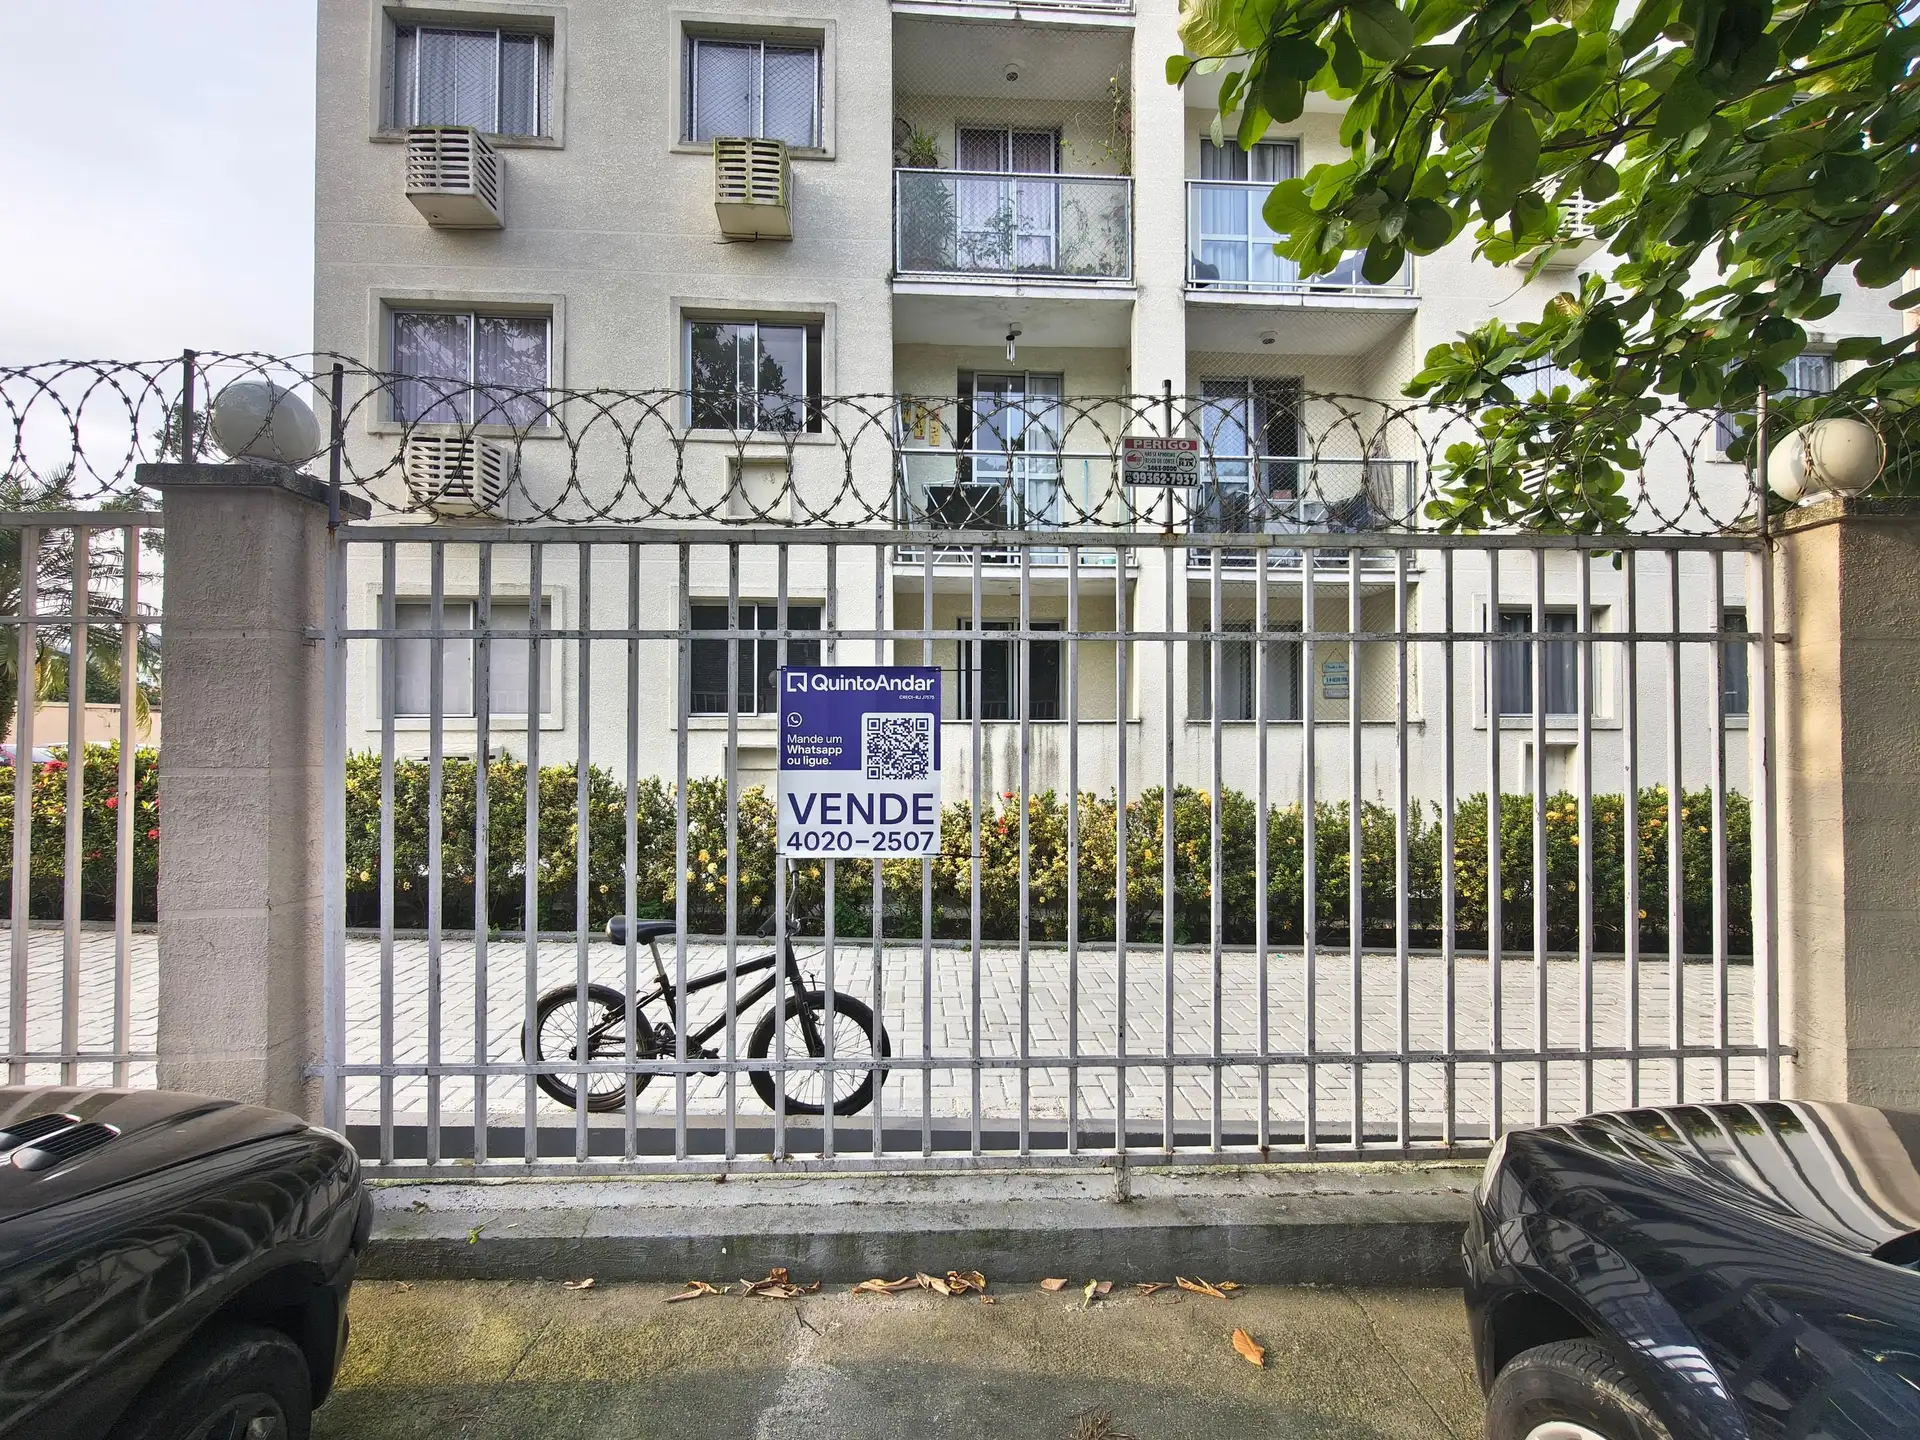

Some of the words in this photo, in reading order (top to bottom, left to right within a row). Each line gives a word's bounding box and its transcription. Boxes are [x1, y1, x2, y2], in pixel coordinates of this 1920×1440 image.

[1133, 439, 1190, 449] PERIGO
[811, 673, 935, 692] QuintoAndar
[787, 734, 823, 744] Mande
[825, 736, 843, 744] um
[787, 744, 843, 756] Whatsapp
[787, 757, 802, 765] ou
[803, 755, 832, 767] ligue.
[787, 793, 934, 825] VENDE
[786, 831, 934, 852] 4020-2507
